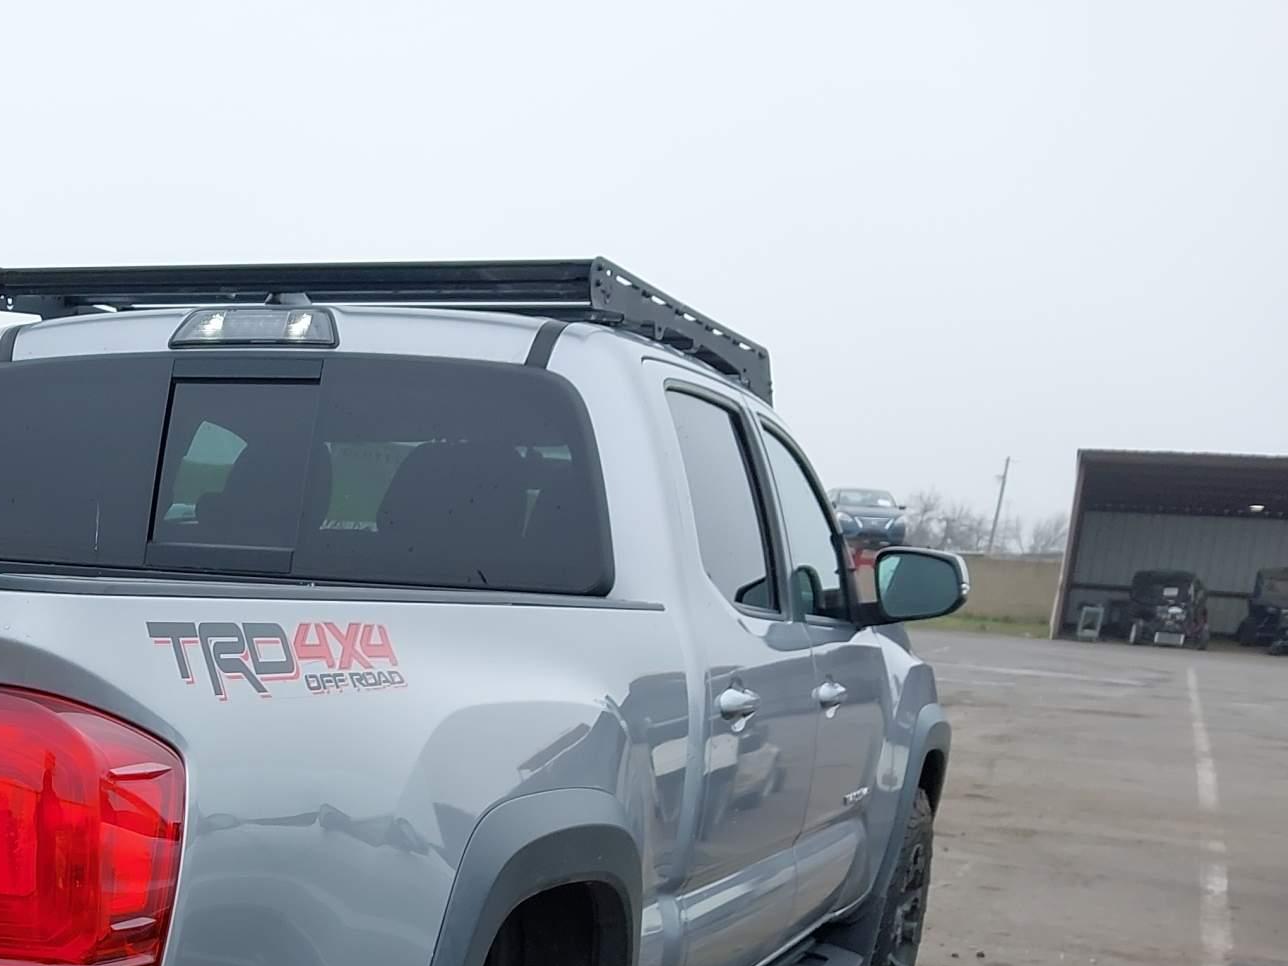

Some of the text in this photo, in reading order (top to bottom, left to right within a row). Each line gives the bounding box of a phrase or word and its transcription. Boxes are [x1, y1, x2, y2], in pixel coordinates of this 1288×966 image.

[146, 621, 399, 701] TRD 4X4
[304, 670, 407, 694] OFF ROAD
